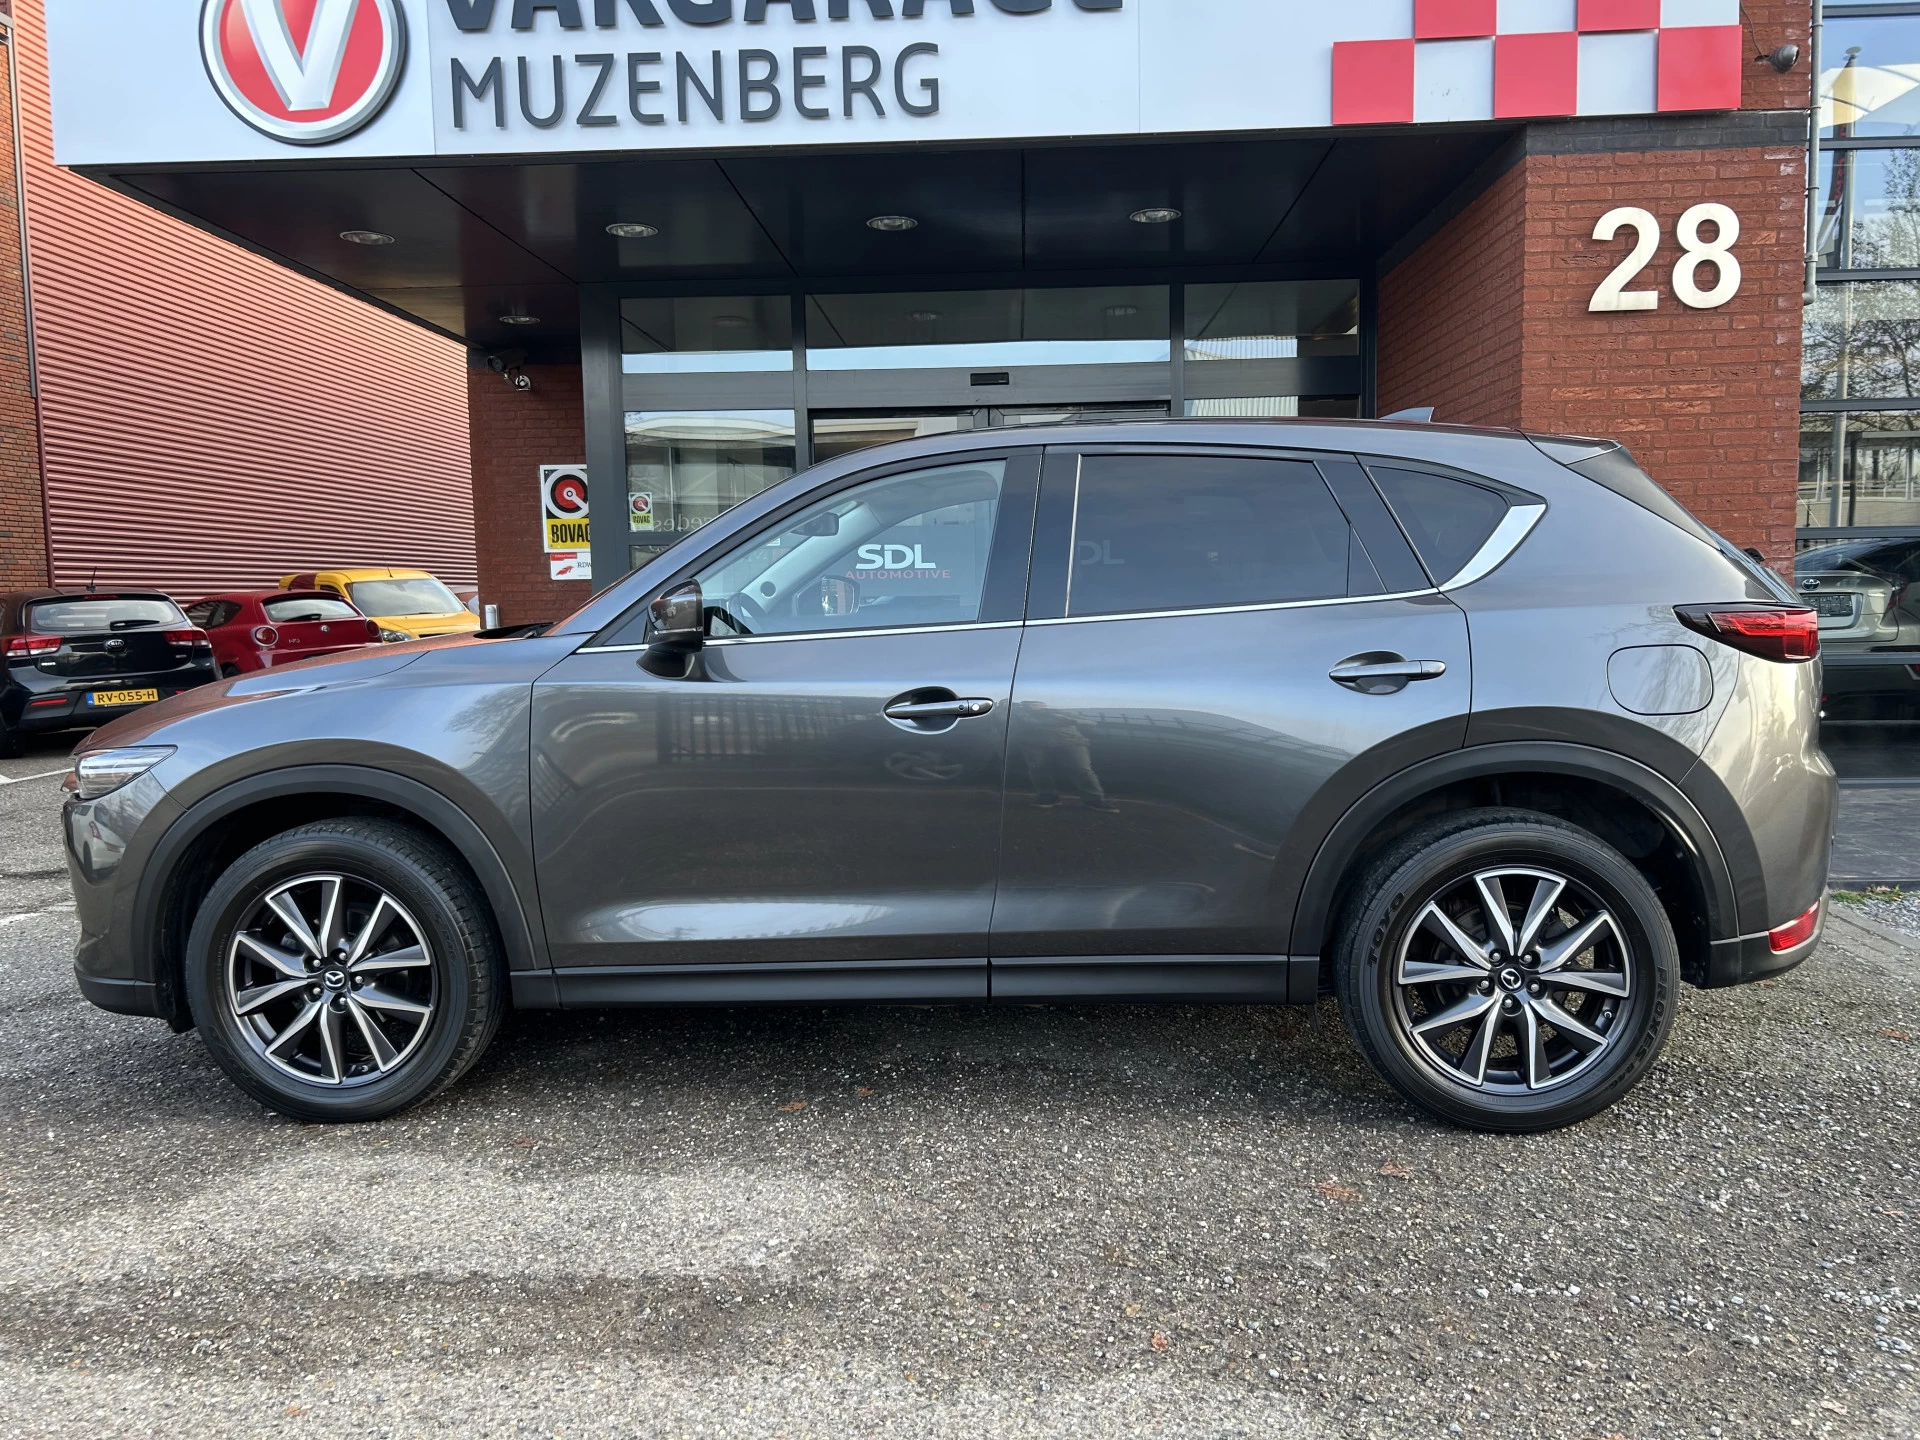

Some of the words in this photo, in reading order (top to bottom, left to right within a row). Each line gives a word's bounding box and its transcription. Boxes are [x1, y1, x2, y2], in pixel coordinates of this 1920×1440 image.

[450, 42, 940, 129] MUZENBERG
[1588, 202, 1741, 312] 28
[845, 569, 952, 580] AUTOMOTIVE
[855, 544, 937, 570] SDL
[97, 690, 155, 704] RV-055-H
[1367, 892, 1405, 968] TOYO
[1635, 966, 1668, 1061] PROXES
